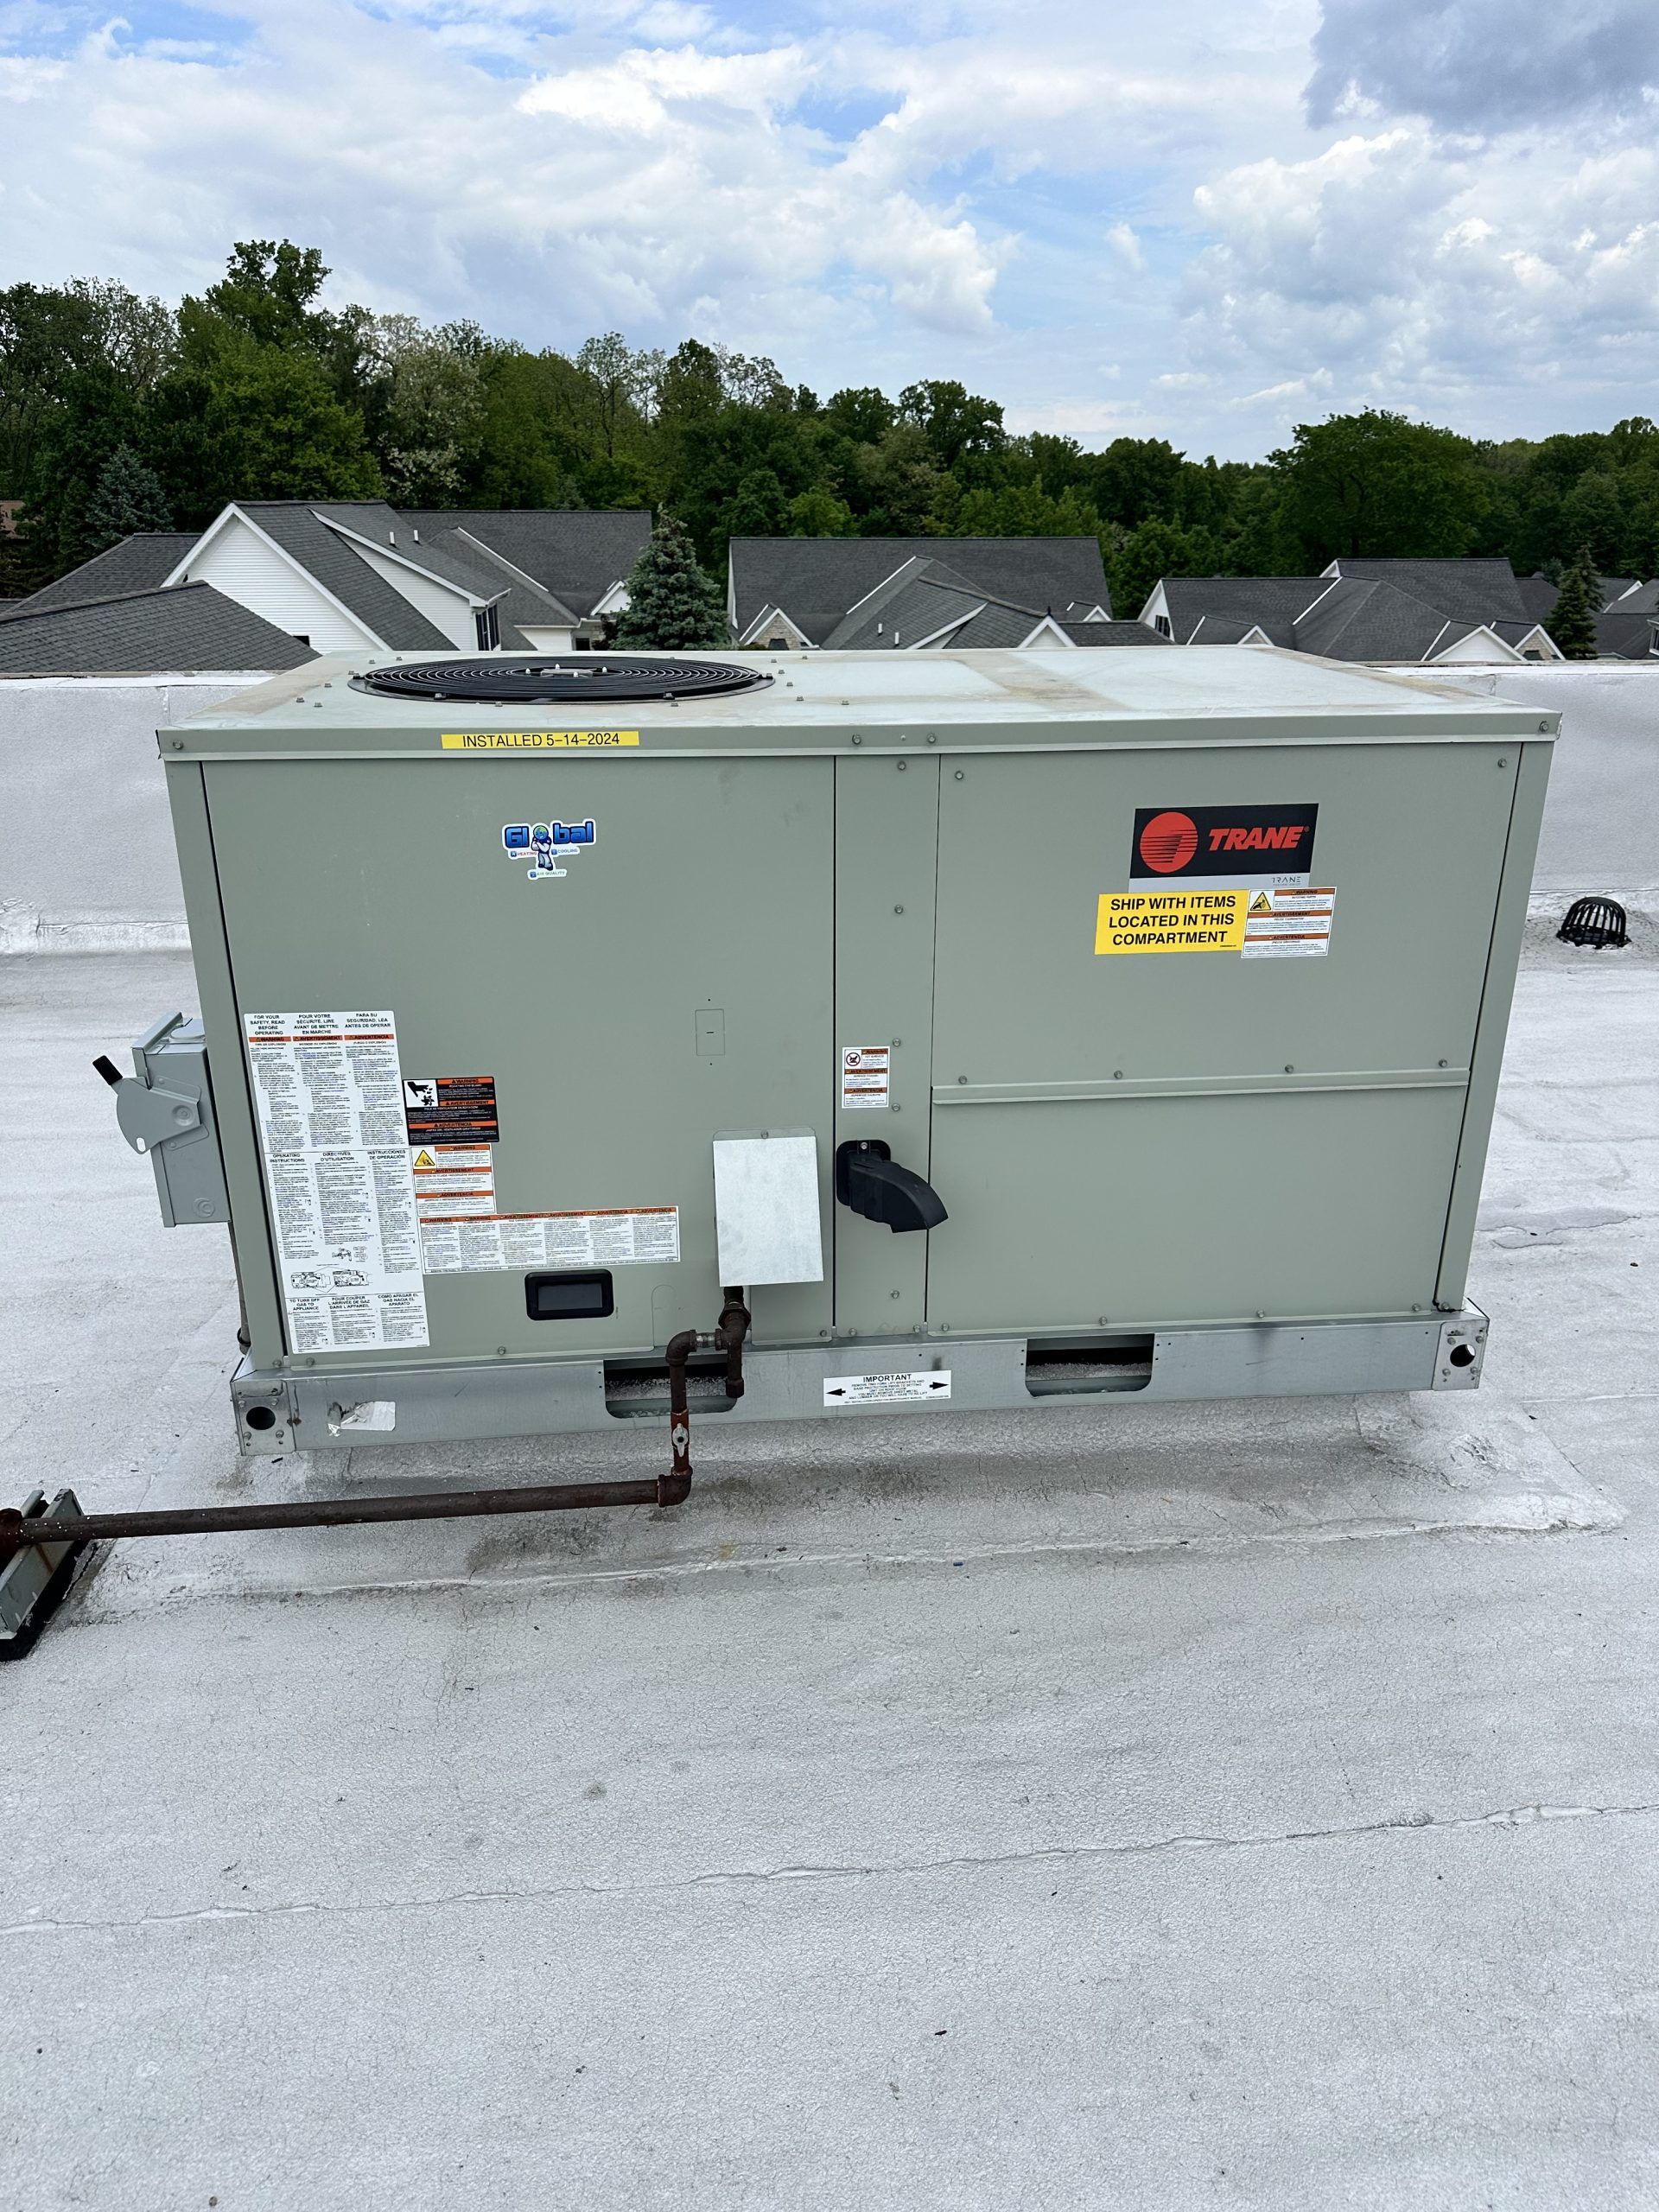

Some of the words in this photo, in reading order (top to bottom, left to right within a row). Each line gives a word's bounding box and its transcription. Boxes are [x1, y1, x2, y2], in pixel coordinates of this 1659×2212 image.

[462, 734, 543, 747] INSTALLED
[546, 733, 620, 747] 5-14-2024
[1209, 826, 1304, 851] TRANE
[1110, 898, 1145, 911] SHIP
[1149, 897, 1186, 910] WITH
[1191, 895, 1236, 908] ITEMS
[1109, 915, 1179, 928] LOCATED
[1183, 915, 1198, 926] IN
[1201, 912, 1234, 925] THIS
[1113, 931, 1228, 945] COMPARTMENT
[863, 1374, 912, 1382] IMPORTANT
